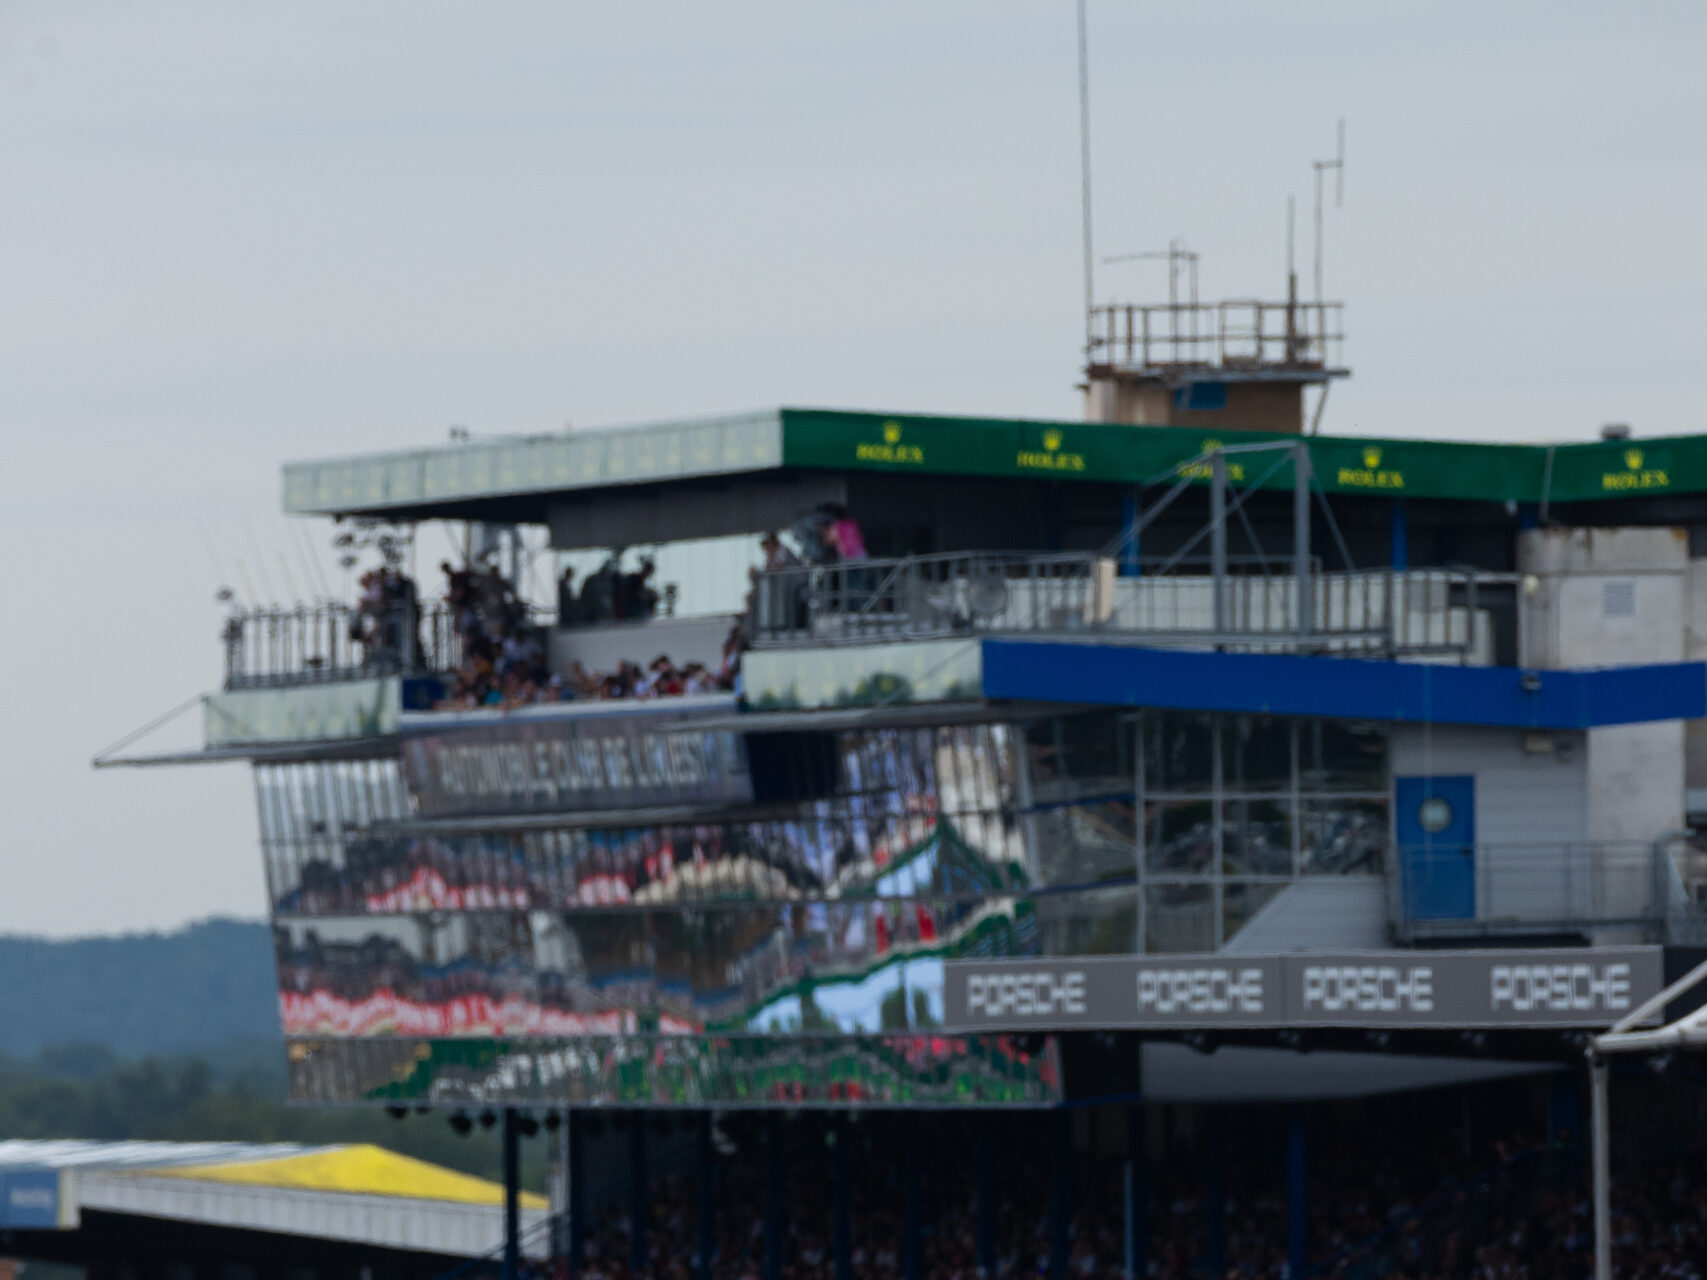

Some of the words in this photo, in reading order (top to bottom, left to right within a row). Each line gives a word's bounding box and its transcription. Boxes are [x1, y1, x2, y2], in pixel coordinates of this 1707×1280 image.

[856, 443, 924, 463] ROLEX
[1017, 451, 1085, 472] ROLEX
[1338, 468, 1404, 489] ROLEX
[1603, 469, 1670, 490] ROLEX
[967, 971, 1086, 1016] PORSCHE
[1137, 969, 1263, 1013] PORSCHE
[1303, 966, 1433, 1011] PORSCHE
[1491, 963, 1631, 1011] PORSCHE
